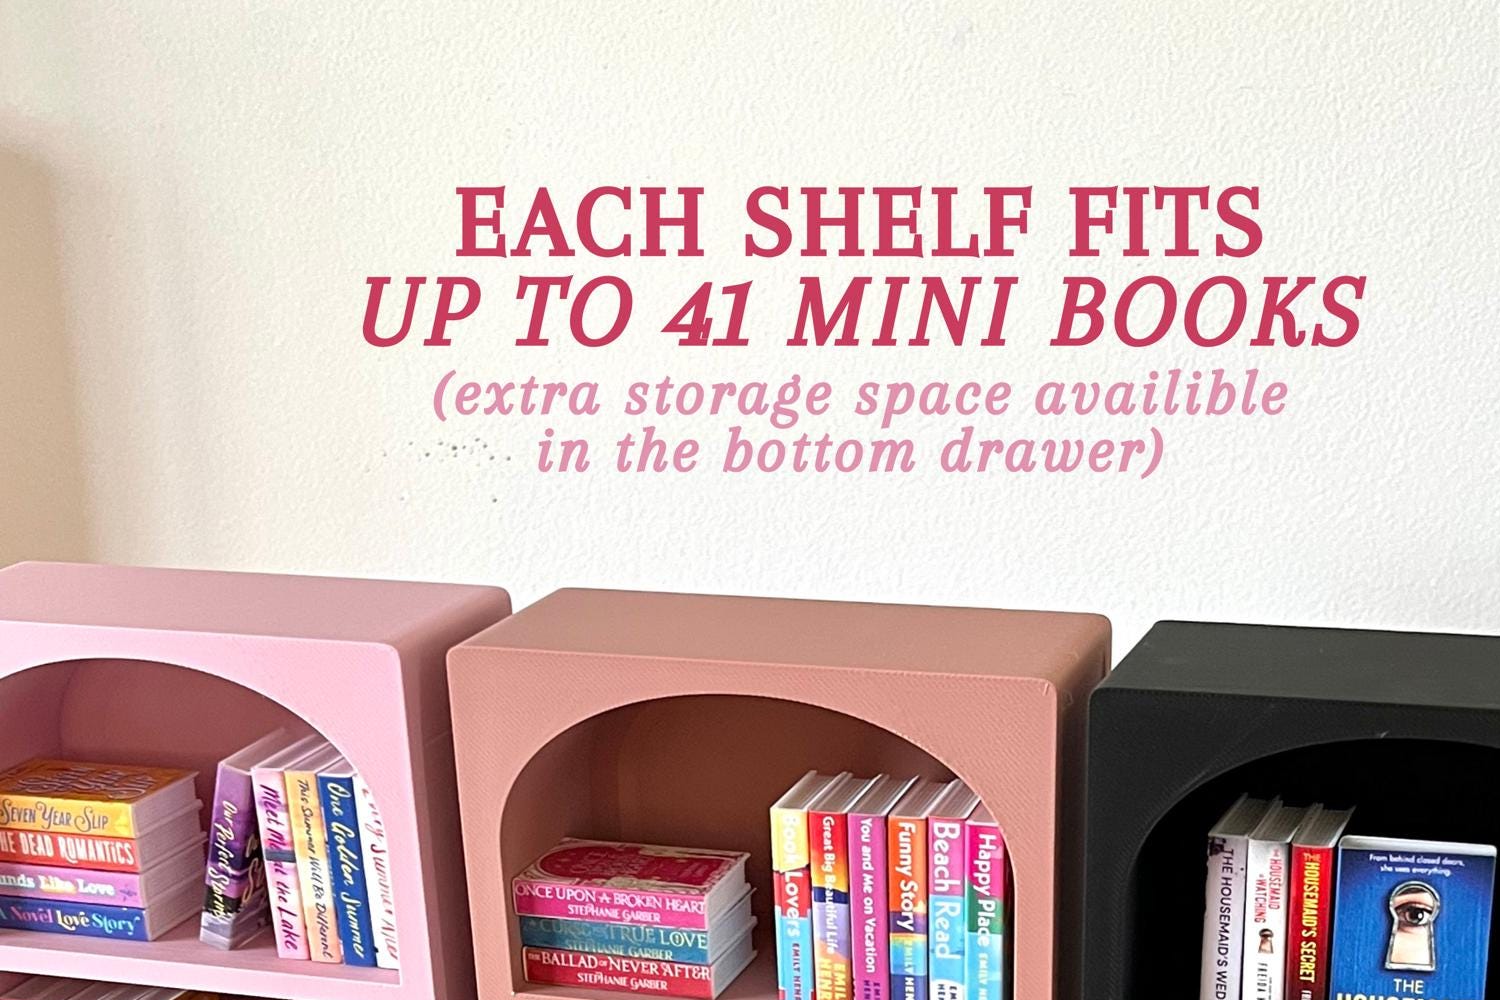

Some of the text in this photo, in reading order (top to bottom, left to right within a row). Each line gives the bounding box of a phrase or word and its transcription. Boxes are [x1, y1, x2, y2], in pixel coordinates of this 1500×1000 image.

[18, 832, 53, 857] DEAD
[895, 821, 918, 932] Funny Story
[1222, 849, 1234, 874] THE
[515, 883, 553, 899] ONCE
[556, 887, 595, 902] UPON
[614, 893, 662, 909] BROKEN
[666, 899, 705, 913] HEART
[859, 818, 876, 974] You and Me on Vacation
[933, 821, 961, 960] Beach Read
[974, 833, 997, 948] Happy Place
[11, 905, 140, 936] Novel Love Story
[568, 904, 661, 923] STEPHANIE GARBER
[1217, 874, 1233, 966] HOUSEMAID'S
[1393, 978, 1424, 994] THE
